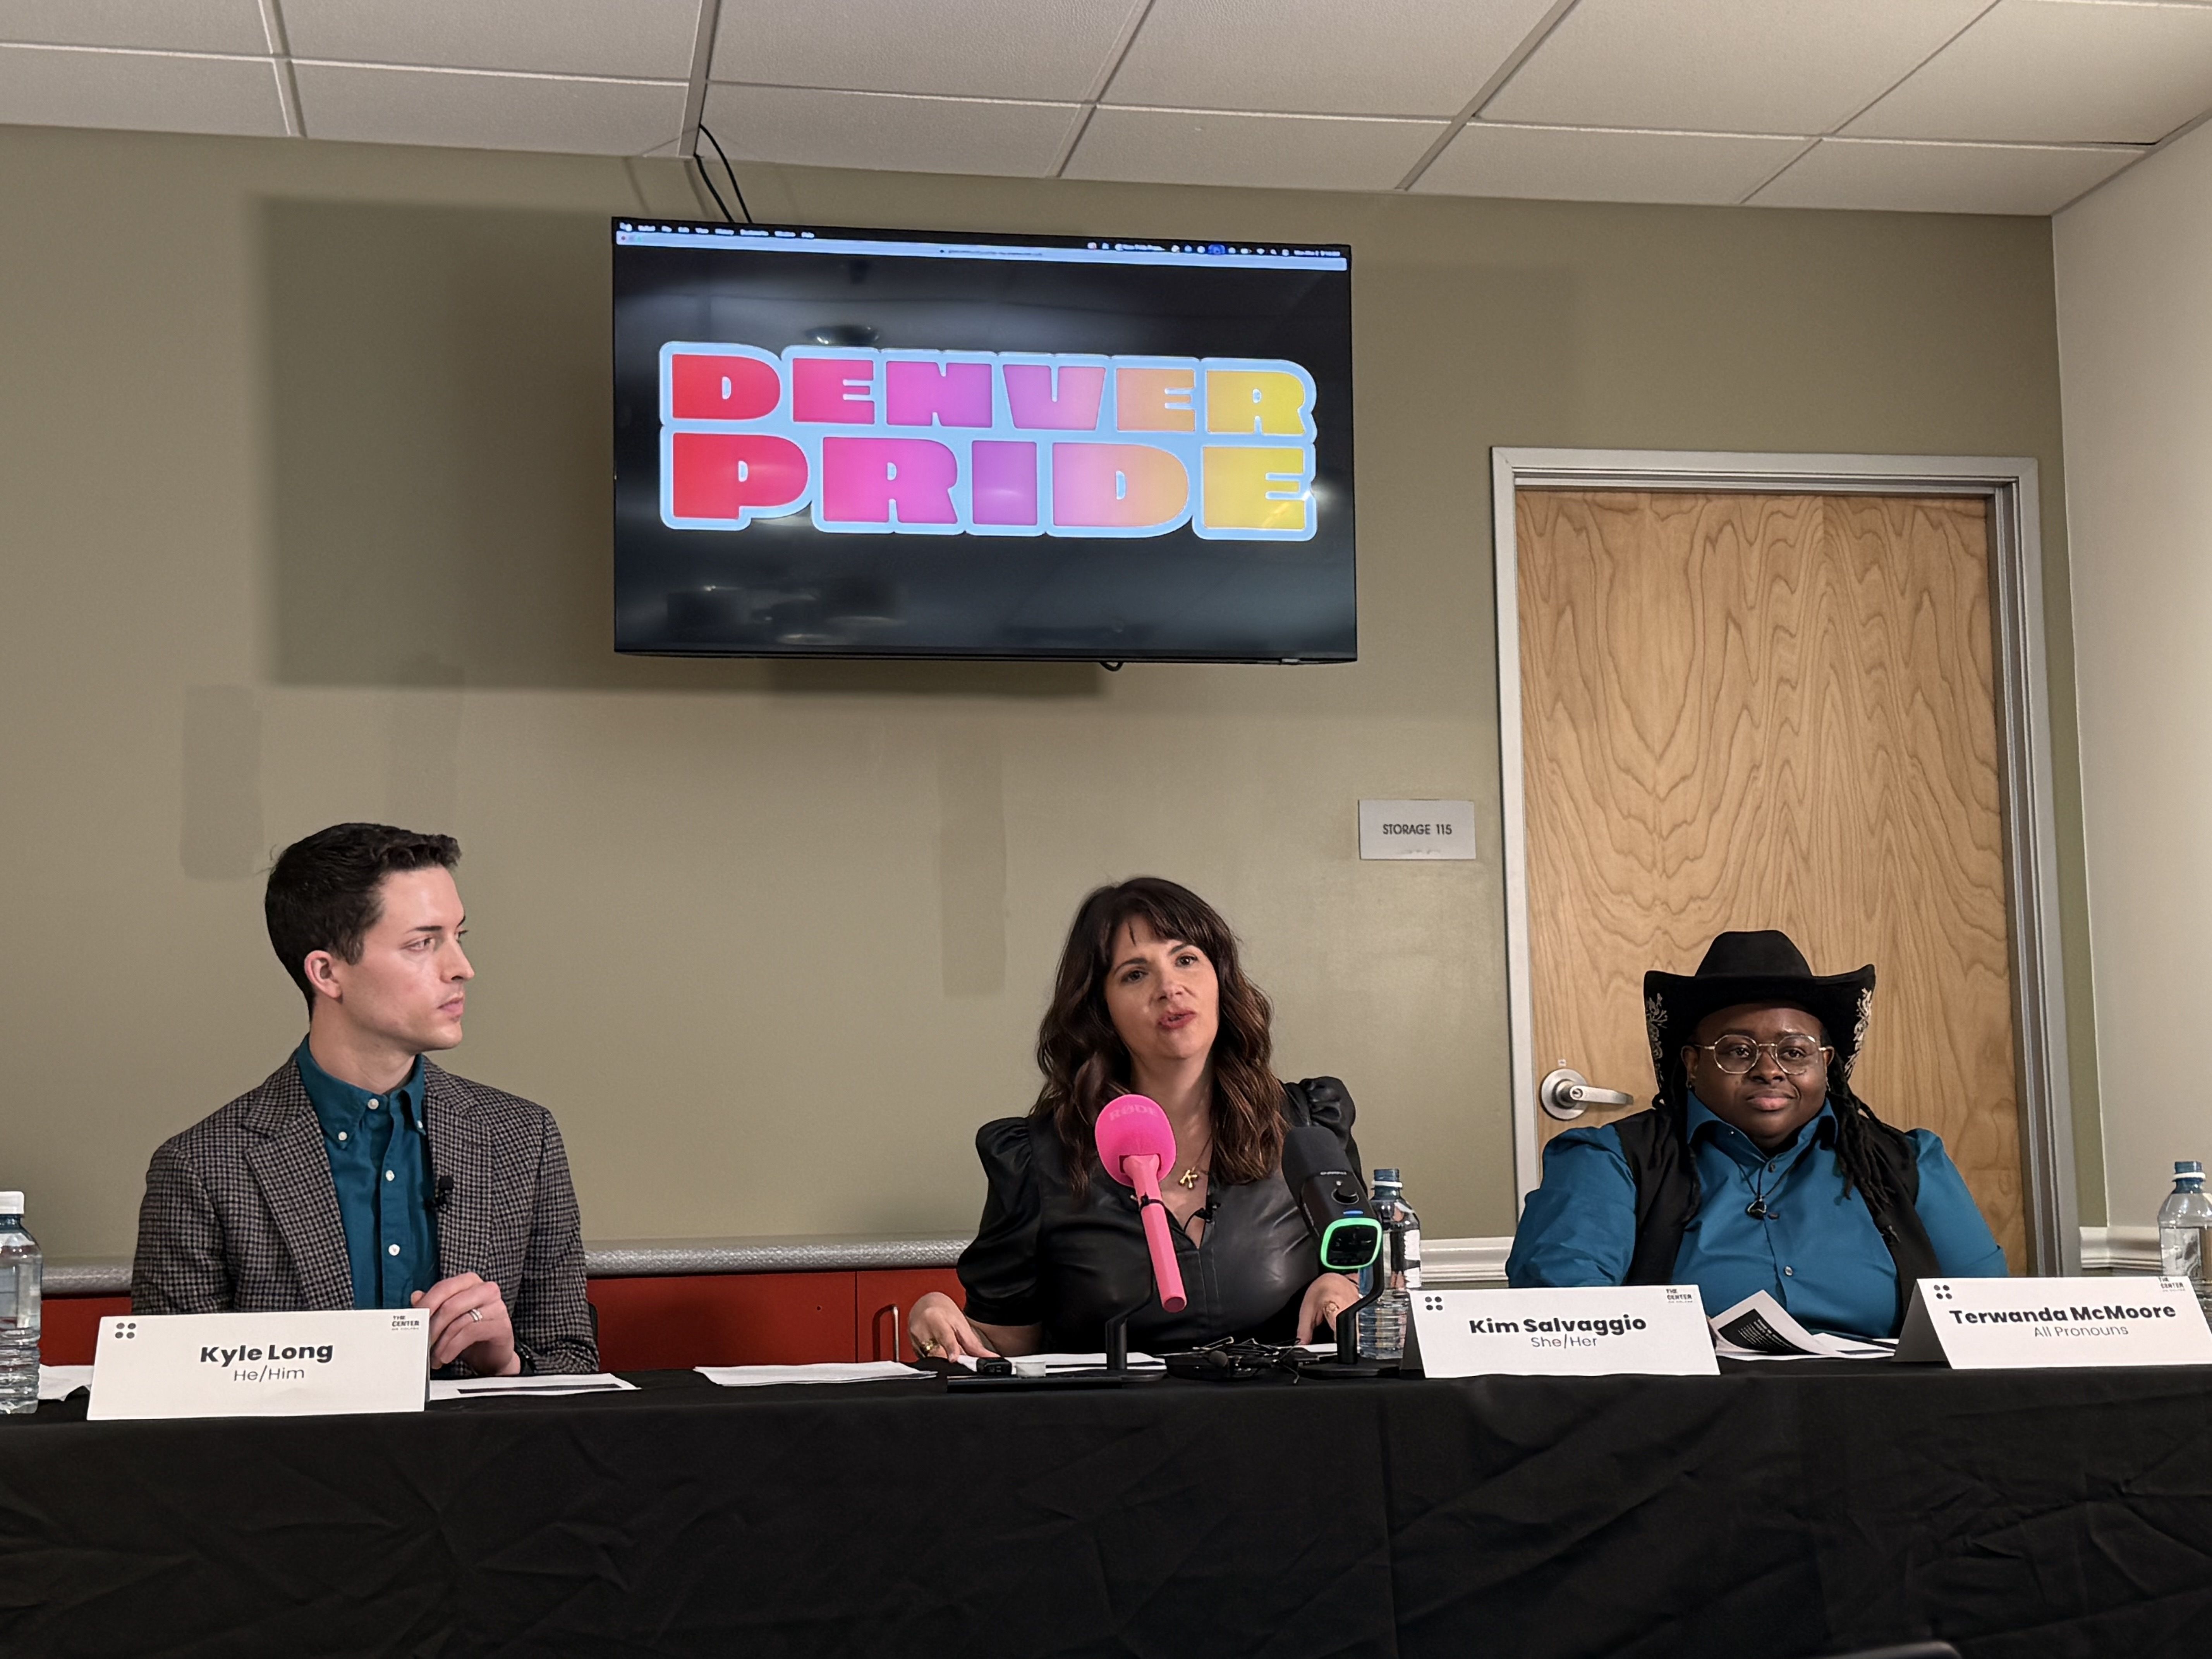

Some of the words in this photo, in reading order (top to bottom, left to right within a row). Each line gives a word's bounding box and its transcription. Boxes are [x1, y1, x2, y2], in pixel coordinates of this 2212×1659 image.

[672, 353, 1305, 435] DENVER
[672, 432, 1304, 530] PRIDE
[1382, 824, 1431, 835] STORAGE
[1436, 824, 1452, 835] 115
[1949, 1307, 2068, 1324] Terwanda
[2070, 1305, 2176, 1321] McMoore
[1469, 1318, 1519, 1334] Kim
[1523, 1314, 1647, 1336] Salvaggio
[2034, 1326, 2052, 1338] All
[2055, 1324, 2129, 1337] Pronouns
[1531, 1335, 1598, 1349] She/Her
[200, 1345, 262, 1368] Kyle
[268, 1344, 333, 1363] Long
[234, 1364, 305, 1383] He/Him
